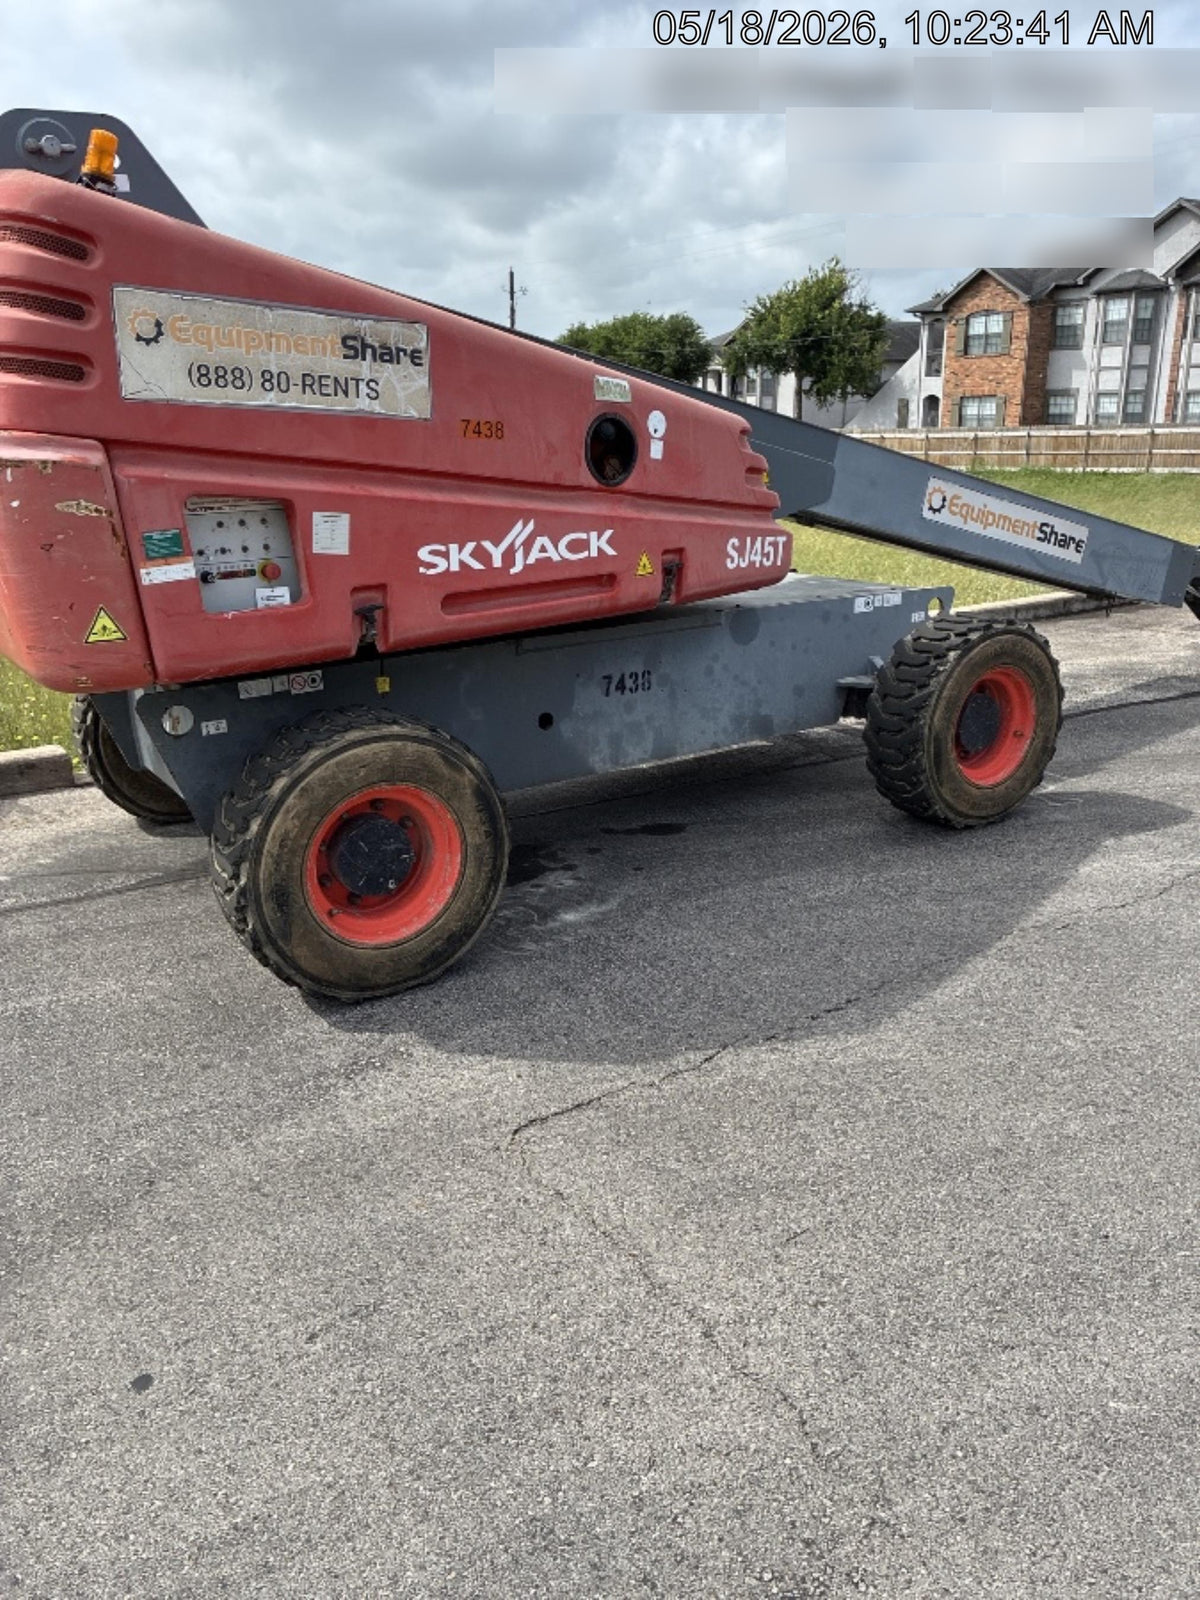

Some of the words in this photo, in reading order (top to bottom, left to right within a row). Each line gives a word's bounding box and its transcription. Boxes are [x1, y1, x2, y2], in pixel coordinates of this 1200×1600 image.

[168, 313, 424, 367] EquipmentShare
[187, 362, 253, 392] (888)
[260, 369, 380, 401] 80-RENTS
[460, 418, 505, 440] 7438
[947, 493, 1085, 554] EquipmentShare
[418, 518, 618, 576] SKYJACK
[726, 535, 787, 570] SJ45T
[602, 669, 652, 697] 7438
